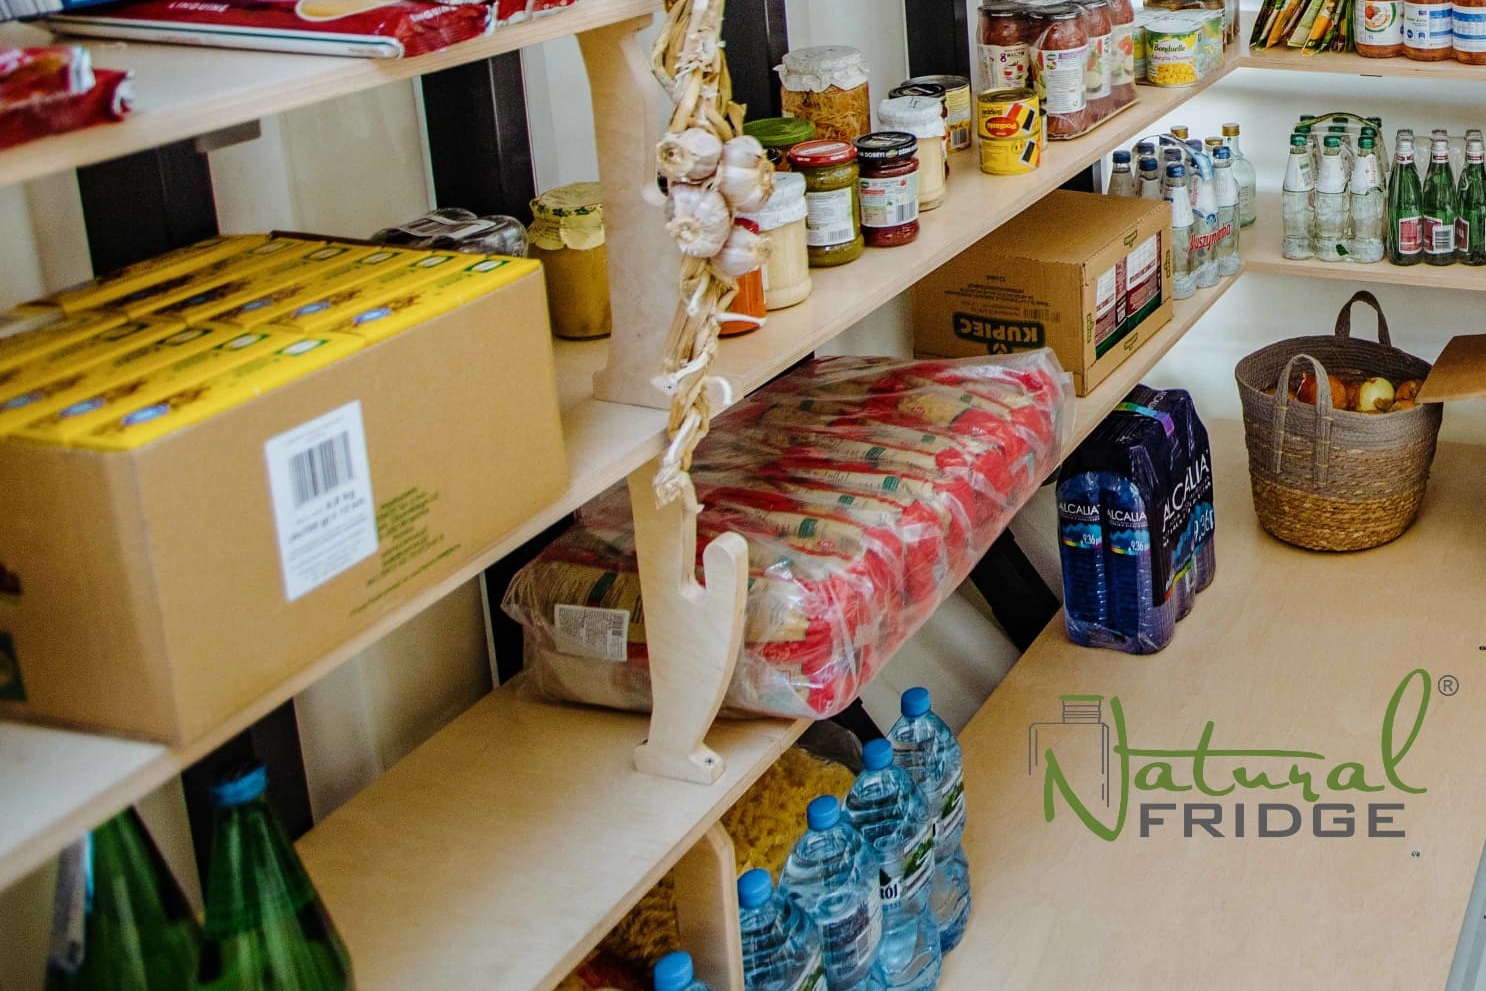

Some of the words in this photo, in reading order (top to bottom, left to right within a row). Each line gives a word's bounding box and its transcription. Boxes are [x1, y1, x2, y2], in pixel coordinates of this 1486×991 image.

[168, 1, 230, 13] LINGUINE
[1153, 42, 1186, 53] Bonduelle
[960, 318, 1038, 343] KUPIEC
[1161, 455, 1211, 532] ALCALIA
[1058, 503, 1099, 516] ALCALIA
[1106, 509, 1148, 522] ALCALIA
